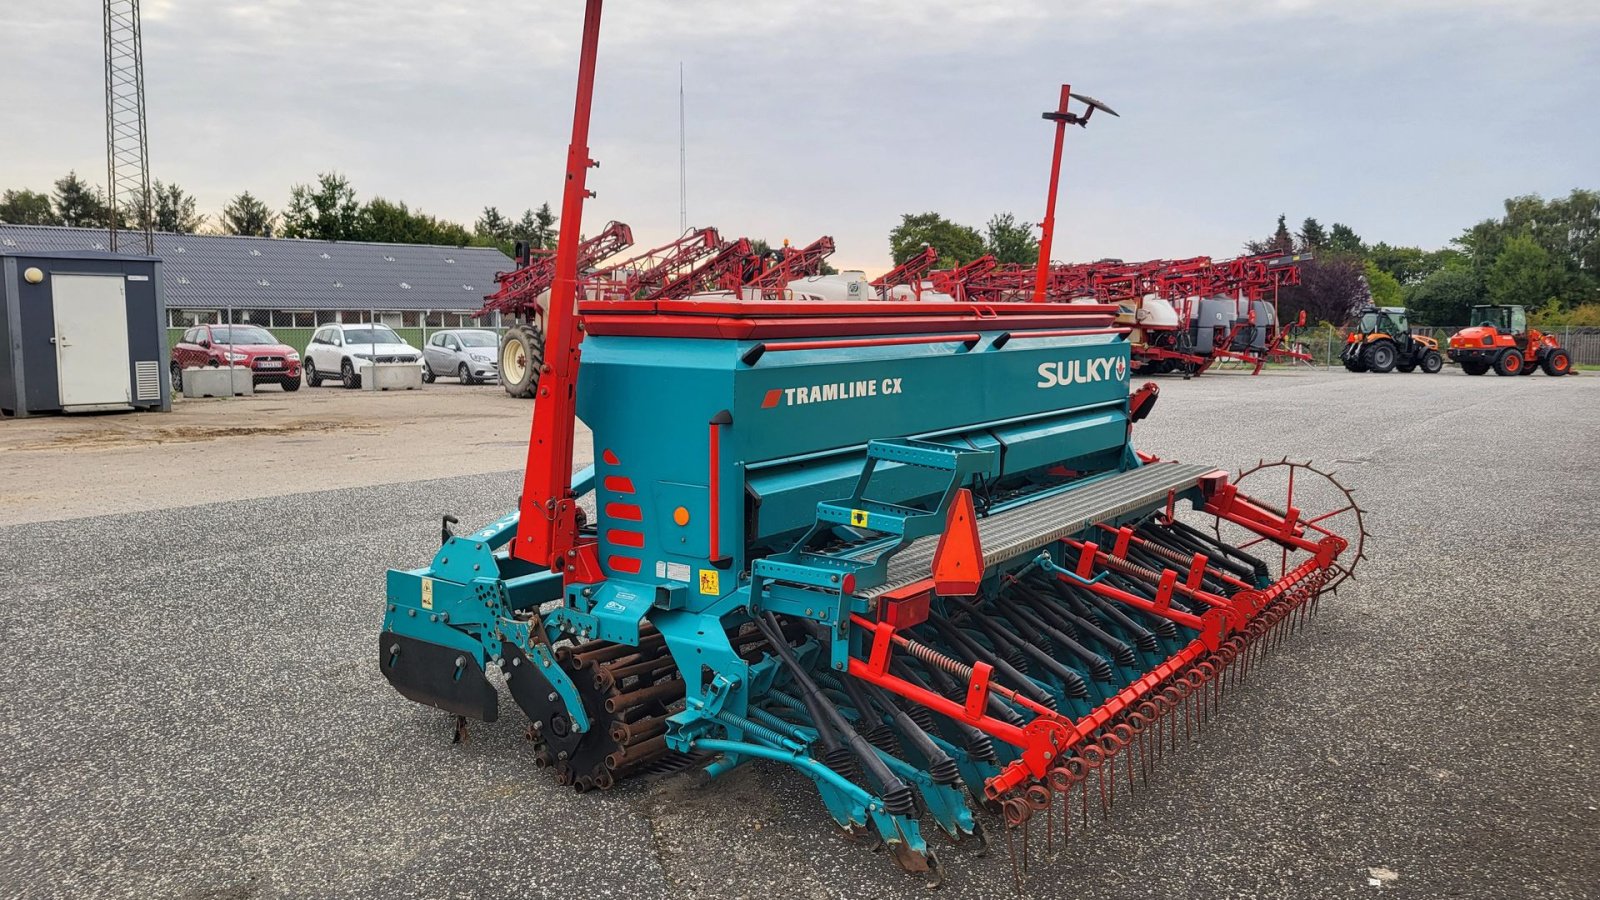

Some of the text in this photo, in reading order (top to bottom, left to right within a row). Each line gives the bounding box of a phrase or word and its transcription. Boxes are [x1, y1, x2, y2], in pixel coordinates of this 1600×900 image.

[1037, 356, 1116, 388] SULKY
[784, 377, 902, 406] TRAMLINE CX
